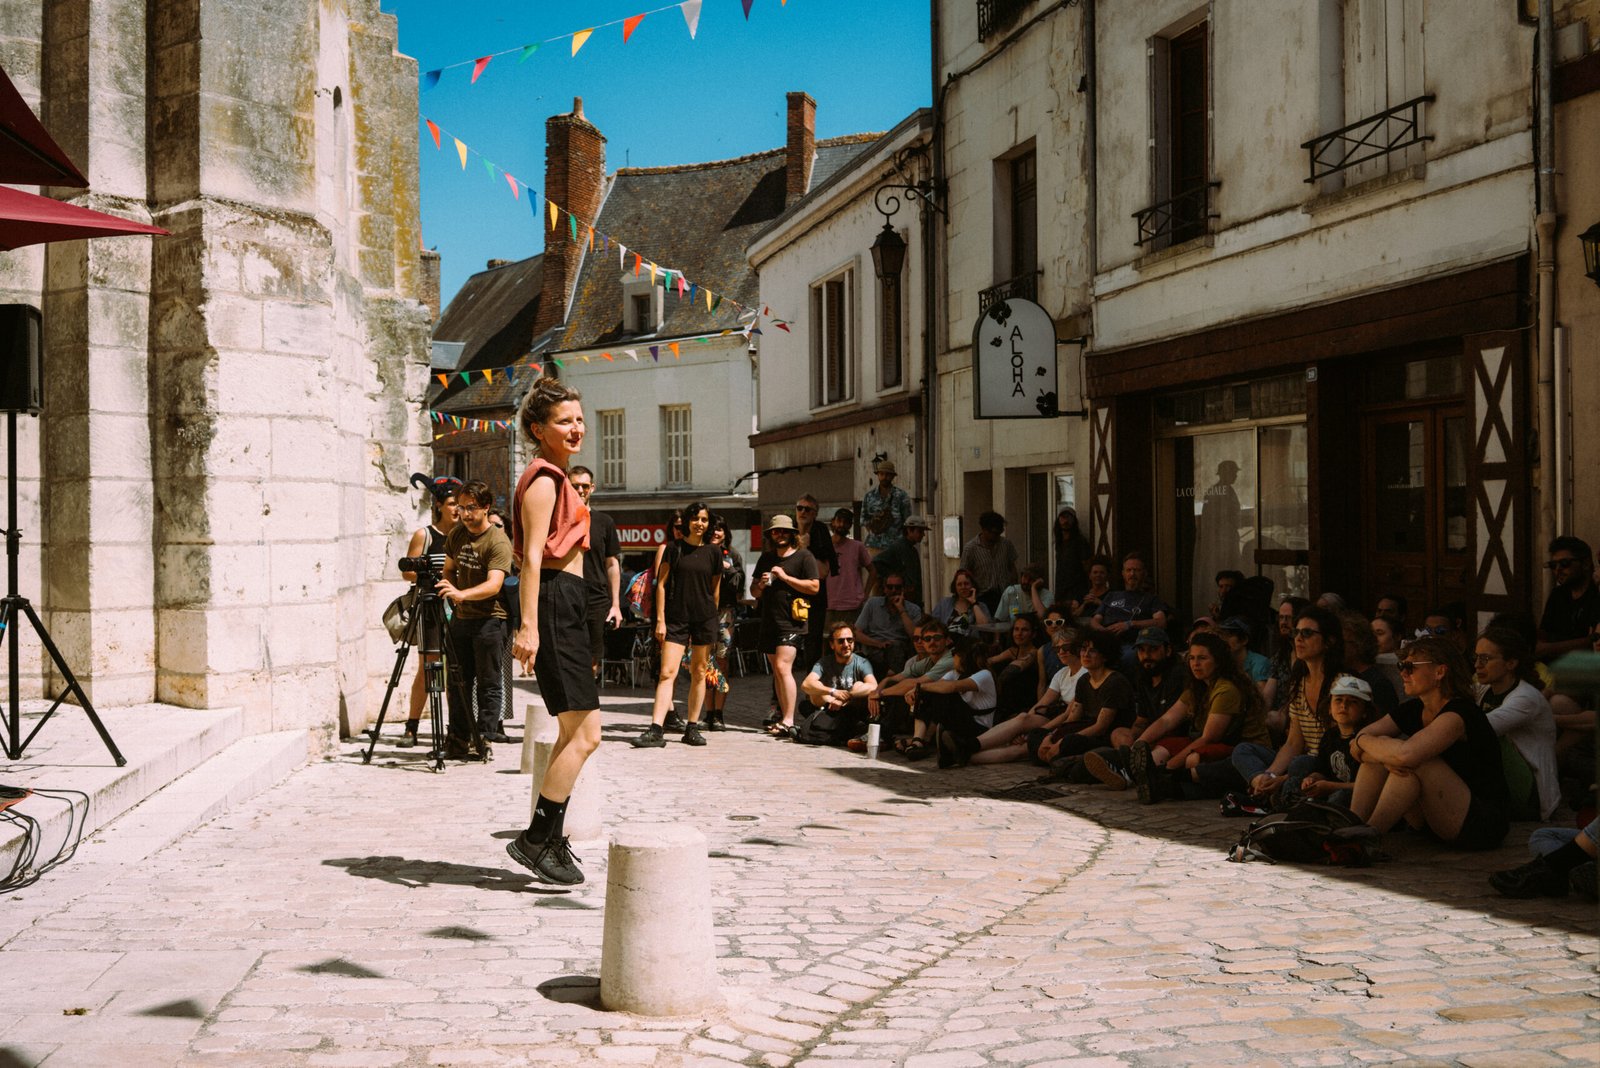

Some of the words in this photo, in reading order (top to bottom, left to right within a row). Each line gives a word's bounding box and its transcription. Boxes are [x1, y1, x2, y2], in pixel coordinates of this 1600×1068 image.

[1009, 325, 1026, 398] ALOHA
[1176, 487, 1185, 498] LA
[1186, 485, 1228, 497] COEGIALE
